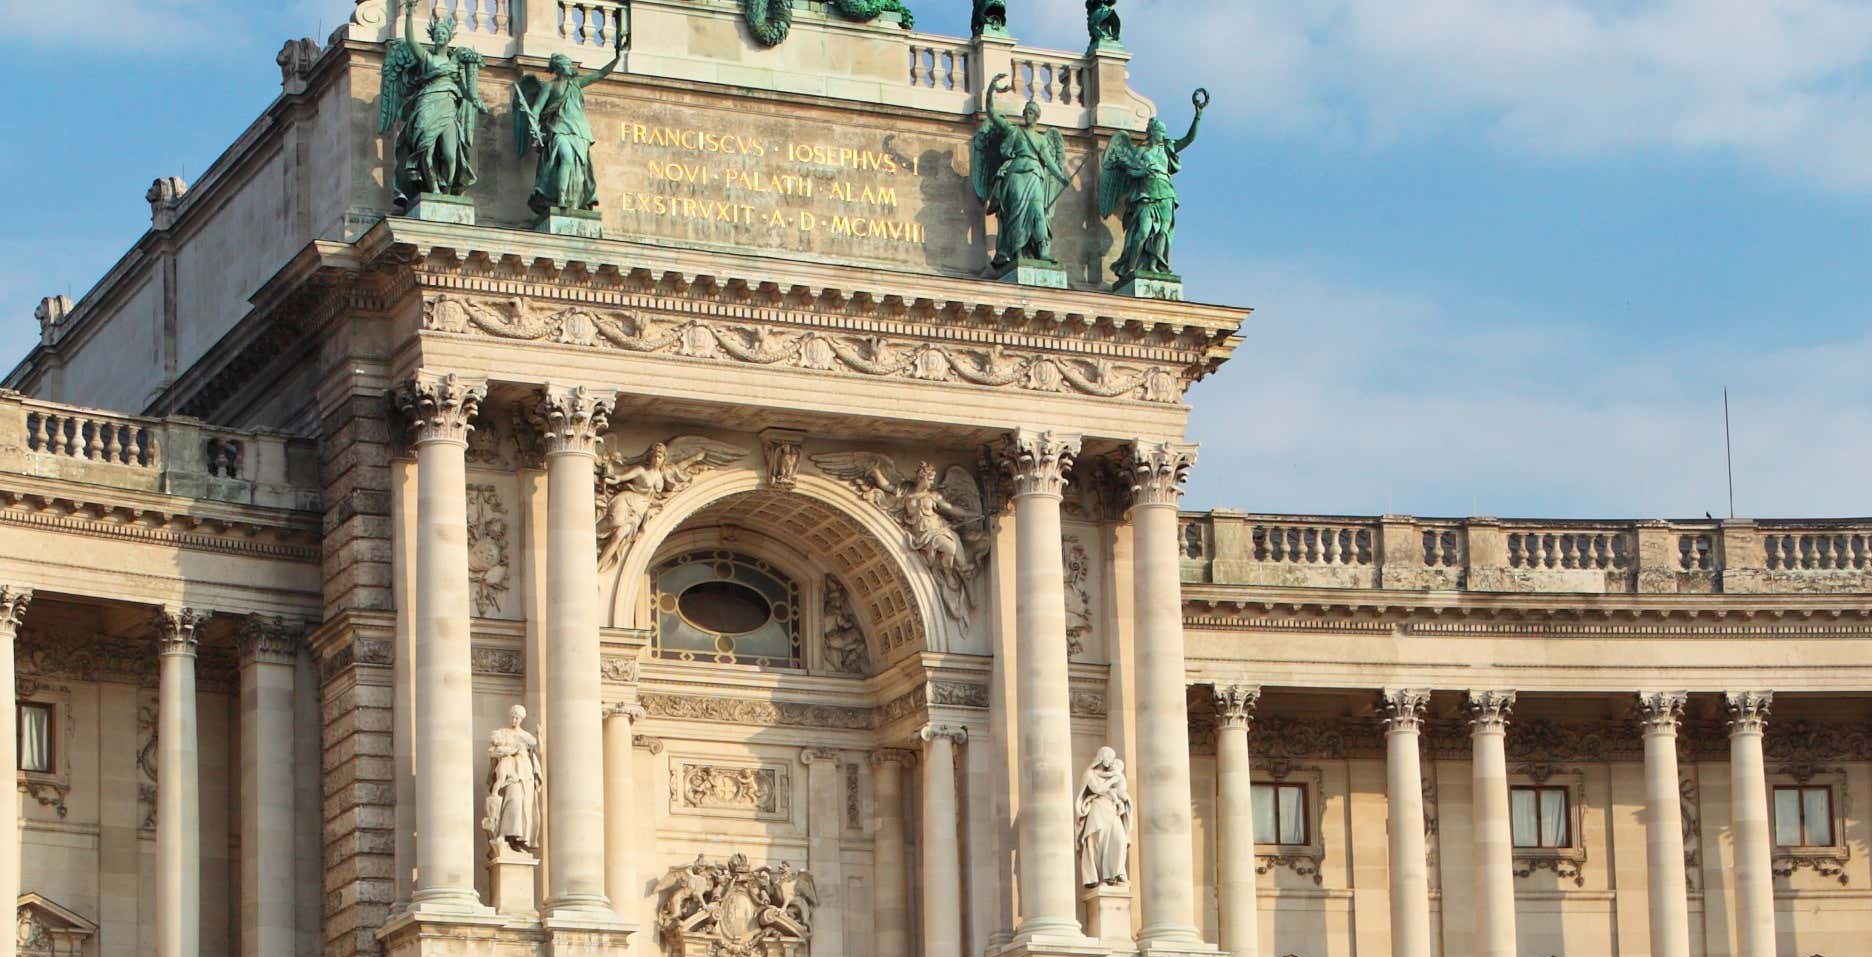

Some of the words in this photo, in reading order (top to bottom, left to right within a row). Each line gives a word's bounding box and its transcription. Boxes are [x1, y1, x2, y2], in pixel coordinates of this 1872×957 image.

[621, 121, 765, 157] FRANCISCVS
[788, 143, 897, 174] IOSEPHVS
[913, 156, 919, 176] I
[649, 160, 707, 185] NOVI
[829, 181, 897, 207] ALAM
[622, 192, 755, 225] EXSTRVXIT
[769, 209, 786, 228] A
[800, 211, 816, 231] D
[831, 215, 925, 243] MCMVIII
